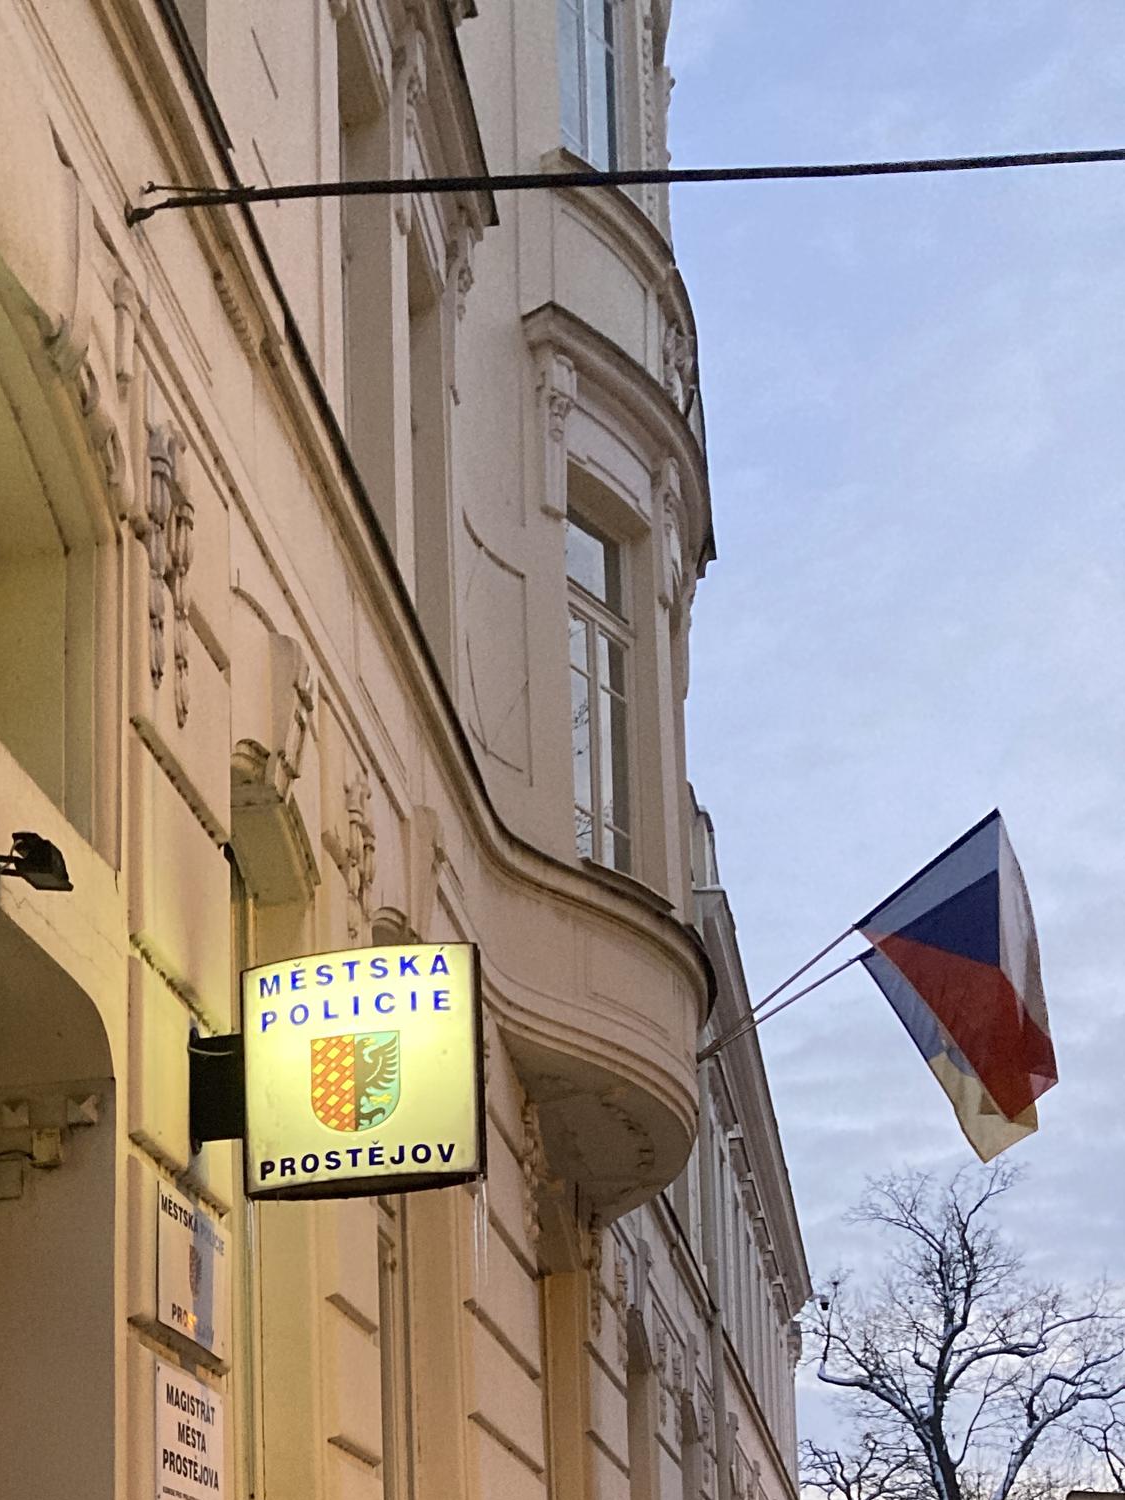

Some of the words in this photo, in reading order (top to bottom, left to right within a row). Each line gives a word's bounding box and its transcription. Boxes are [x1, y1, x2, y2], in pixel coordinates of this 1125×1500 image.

[259, 946, 450, 999] MĚSTSKÁ
[261, 989, 452, 1033] POLICIE
[260, 1140, 456, 1181] PROSTĚJOV
[161, 1193, 198, 1233] MĚSTSKÁ
[166, 1382, 216, 1427] MAGISTRÁT
[177, 1419, 207, 1454] MĚSTA
[162, 1448, 220, 1492] PROSTĚJOVA
